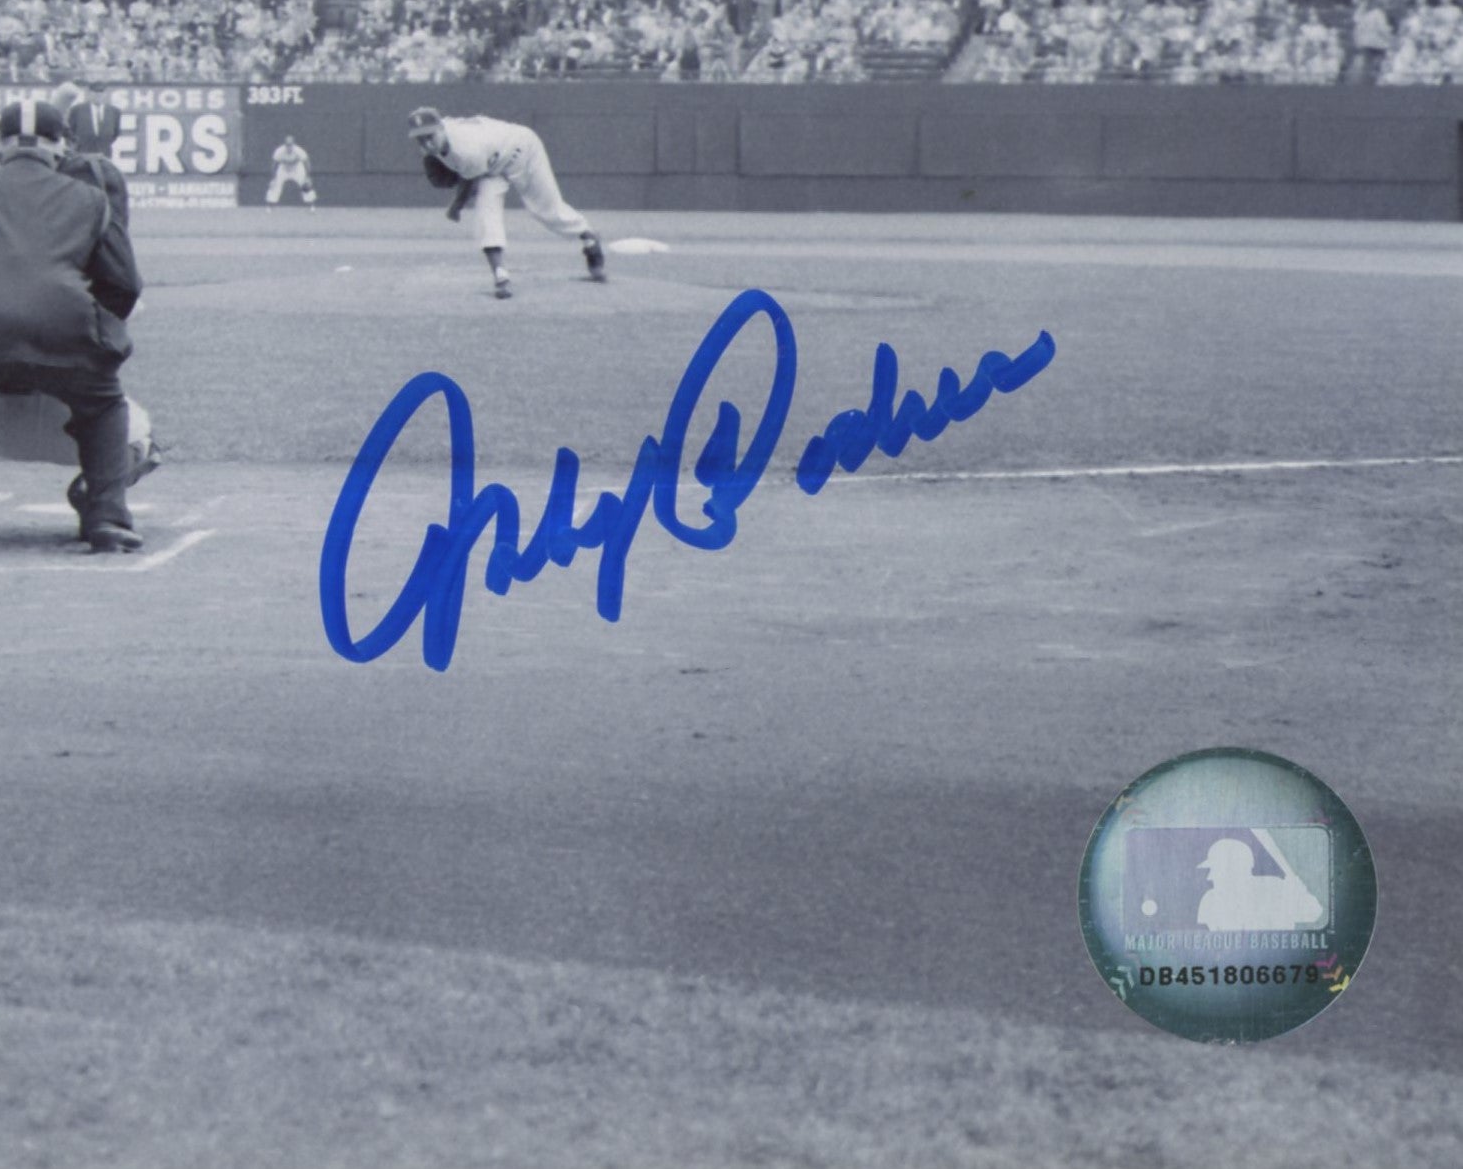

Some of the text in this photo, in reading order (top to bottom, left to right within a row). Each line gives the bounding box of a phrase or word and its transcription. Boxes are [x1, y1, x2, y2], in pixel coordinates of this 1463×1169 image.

[110, 88, 226, 111] SHOES
[1124, 933, 1329, 950] MAJOR LEAGUE BASEBALL
[1139, 965, 1320, 986] DB451806679
